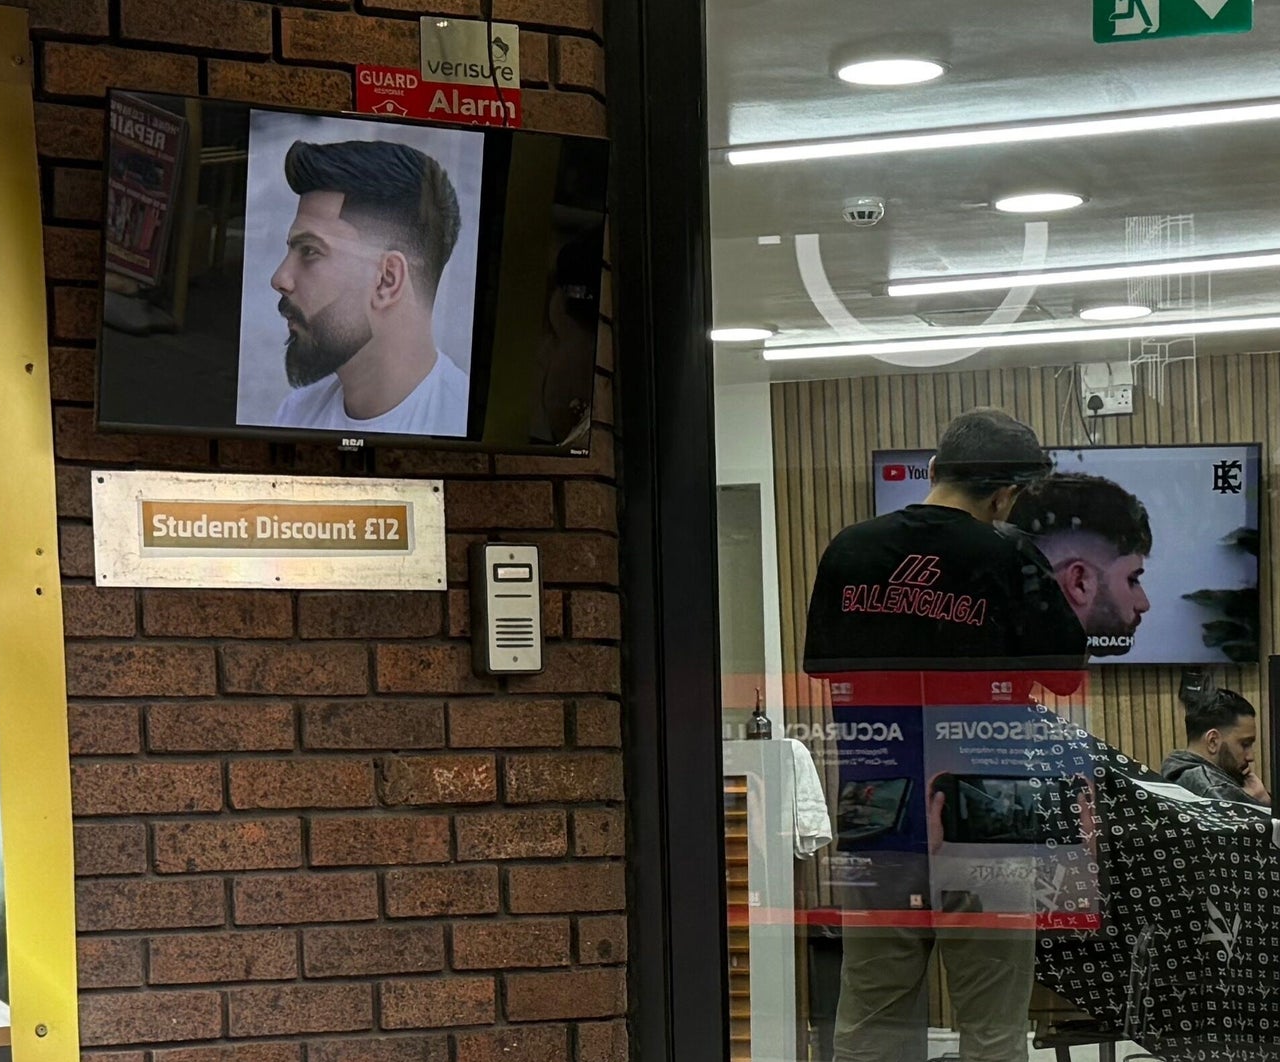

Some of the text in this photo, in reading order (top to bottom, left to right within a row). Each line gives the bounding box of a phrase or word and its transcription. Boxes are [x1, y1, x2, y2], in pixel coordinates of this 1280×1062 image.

[359, 69, 419, 89] GUARD
[427, 60, 514, 82] verisure
[428, 89, 516, 119] Alarm
[342, 438, 364, 447] RCA
[152, 513, 400, 540] Student Discount £12
[841, 584, 987, 627] BALENCIAGA
